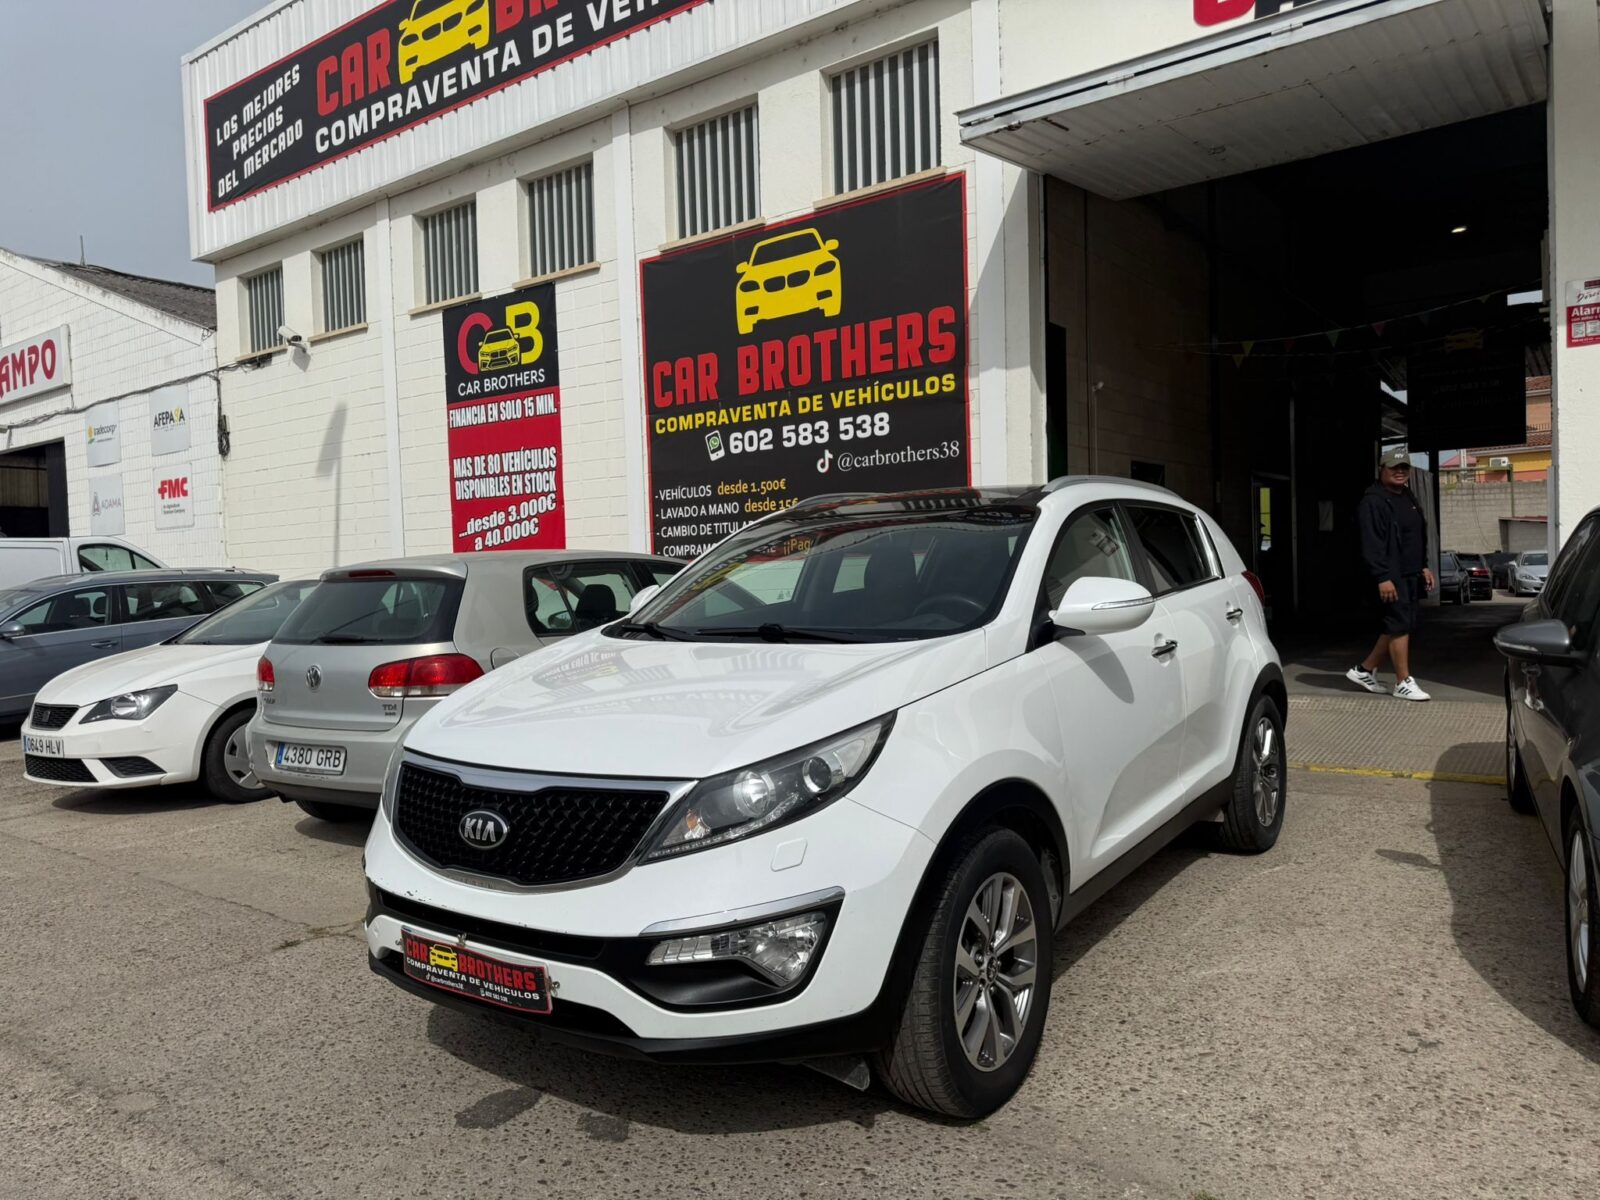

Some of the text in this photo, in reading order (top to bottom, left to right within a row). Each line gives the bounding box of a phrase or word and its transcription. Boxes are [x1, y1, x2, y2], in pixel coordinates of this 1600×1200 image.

[315, 27, 392, 117] CAR
[315, 39, 522, 154] COMPRAVENTA
[532, 12, 574, 59] DE
[216, 64, 301, 147] LOS MEJORES
[232, 105, 284, 161] PRECIOS
[217, 118, 303, 199] DEL MERCADO
[652, 305, 956, 409] CAR BROTHERS
[457, 368, 546, 397] CAR BROTHERS
[449, 393, 558, 429] FINANCIA EN SOLO 15 MIN.
[655, 372, 956, 435] COMPRAVENTA DE VEHÍCULOS
[729, 411, 891, 454] 602 583 538
[453, 446, 557, 479] MAS DE 80 VEHÍCULOS
[836, 440, 960, 473] @carbrothers38
[158, 476, 189, 500] FMC
[455, 470, 557, 501] DISPONIBLES EN STOCK
[717, 479, 749, 496] desde
[750, 478, 787, 496] 1.500€
[507, 493, 557, 523] 3.000€
[700, 504, 708, 517] A
[708, 501, 740, 515] MANO
[744, 497, 776, 513] desde
[474, 517, 539, 551] a 40.000€
[700, 523, 712, 536] DE
[662, 543, 716, 557] COMPRAM
[45, 739, 61, 755] HLV
[284, 745, 342, 769] 4380 GRB
[464, 817, 497, 842] KIA
[406, 937, 537, 992] CAR BROTHERS
[406, 956, 540, 1001] COMPRAVENTA DE VEHÍCULOS
